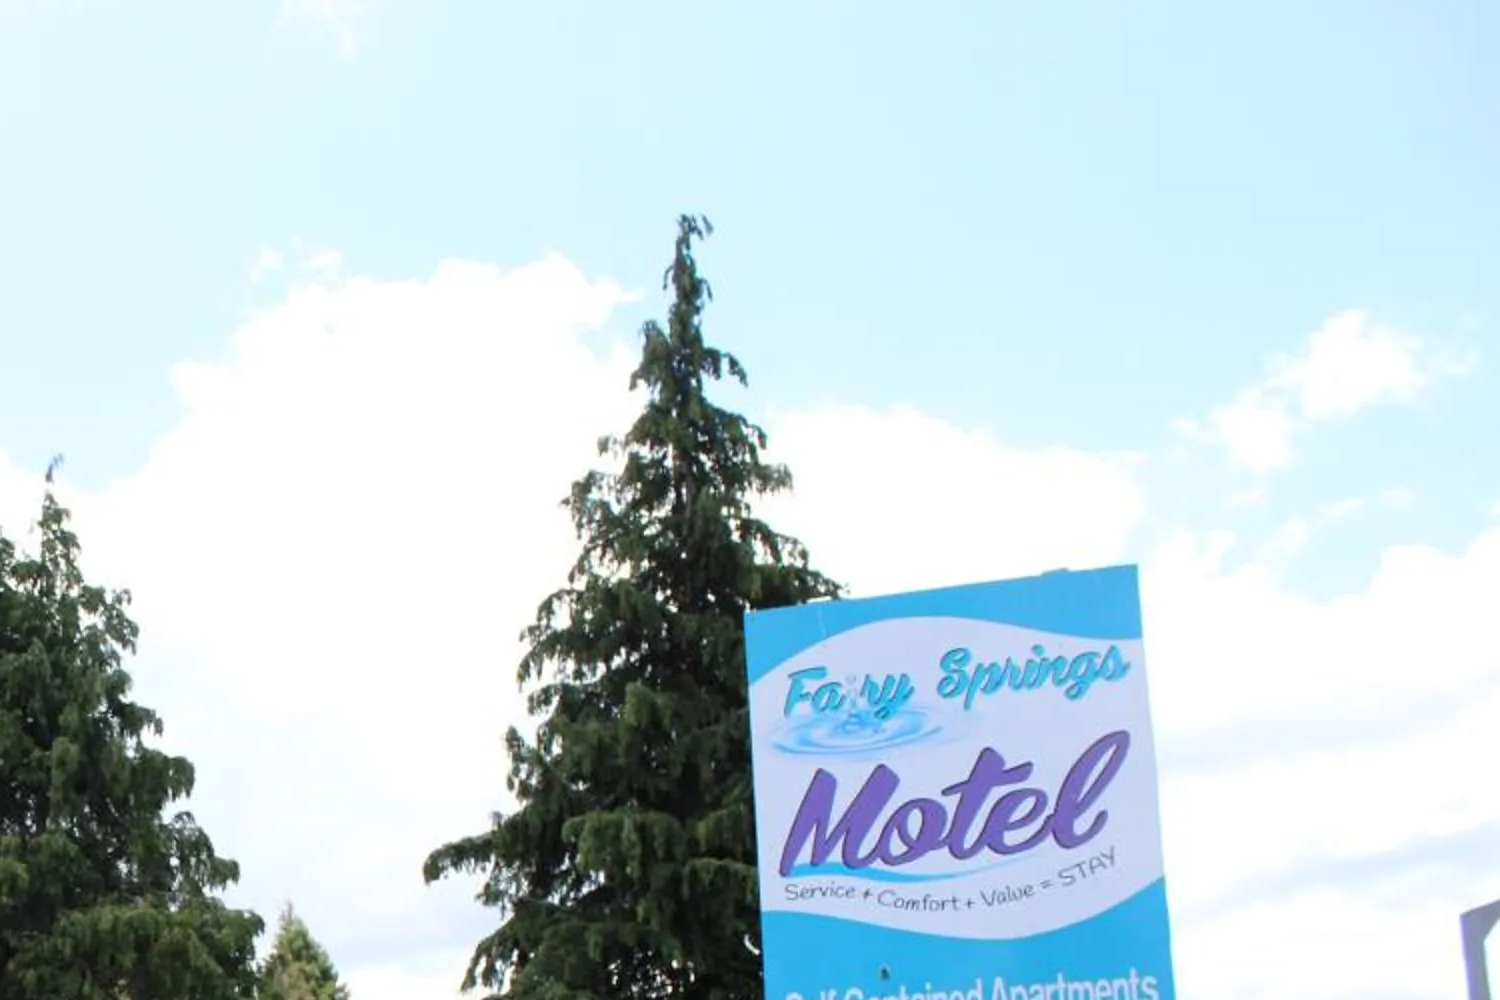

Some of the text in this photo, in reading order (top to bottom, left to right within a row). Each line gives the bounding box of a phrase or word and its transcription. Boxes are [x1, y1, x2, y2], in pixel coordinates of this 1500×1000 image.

[937, 644, 1131, 710] Springs
[779, 730, 1130, 877] Motel
[784, 882, 856, 900] Service
[877, 889, 959, 912] Comfort
[980, 885, 1035, 906] Value
[1058, 846, 1115, 886] STAY
